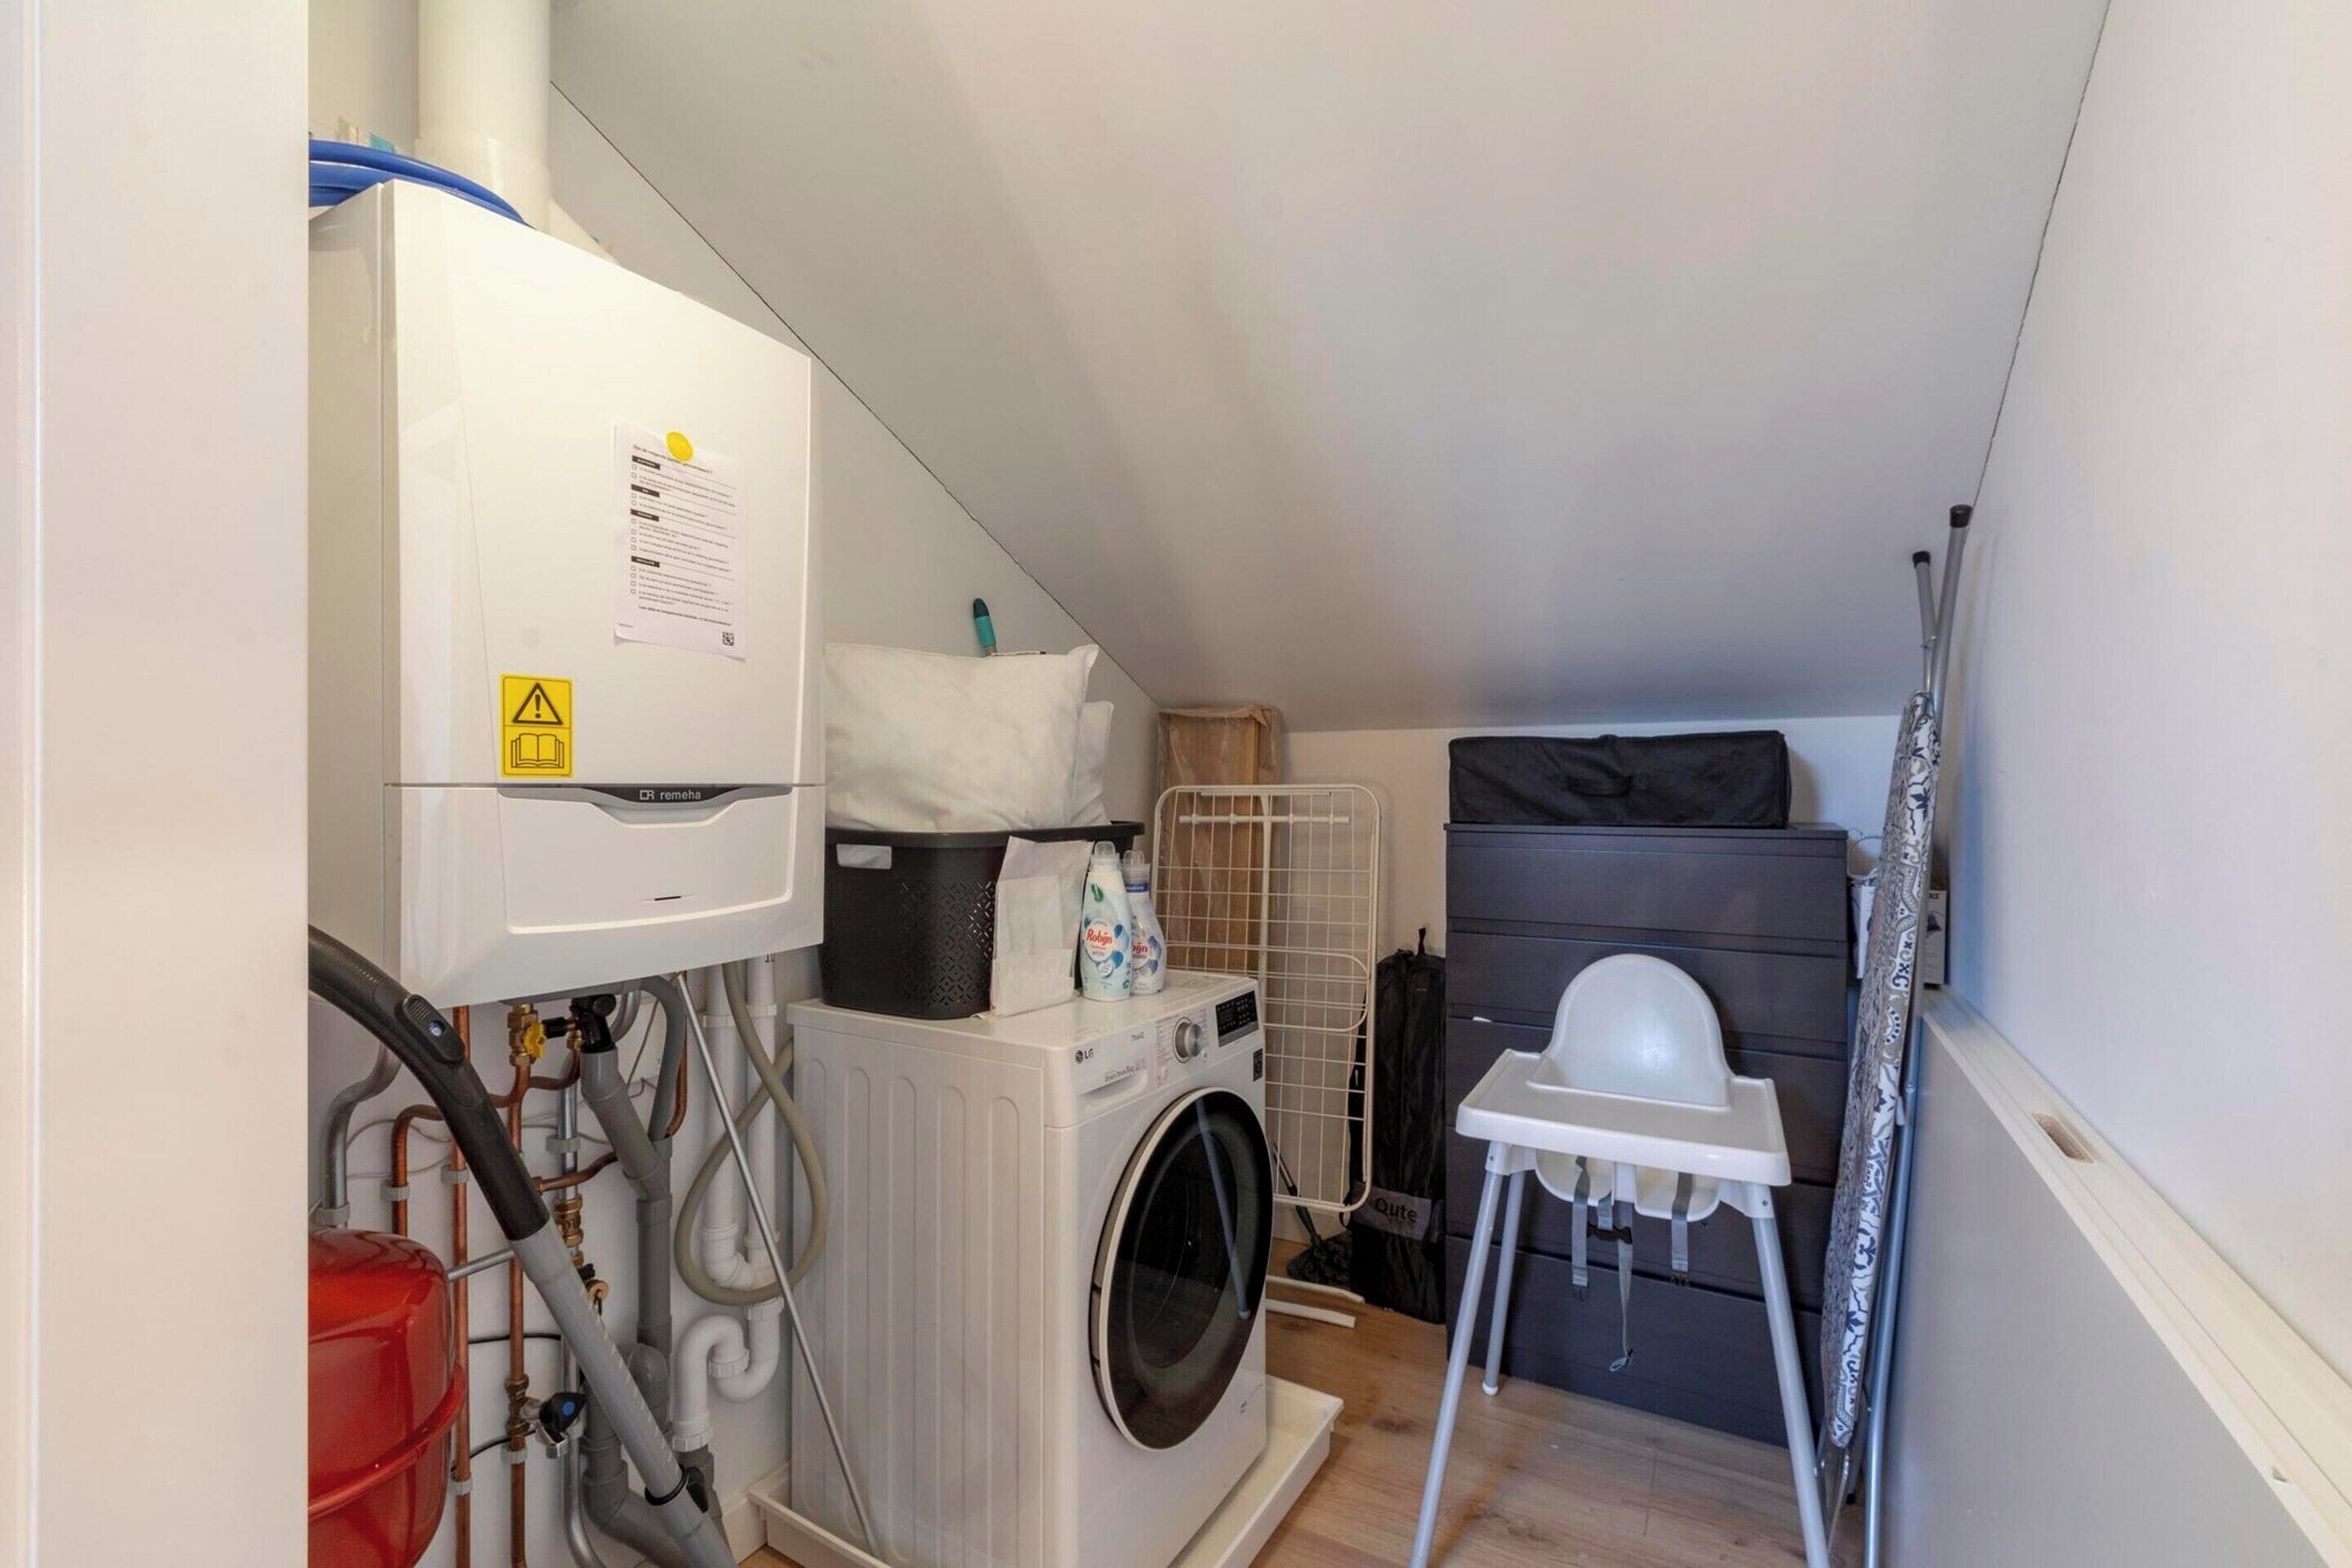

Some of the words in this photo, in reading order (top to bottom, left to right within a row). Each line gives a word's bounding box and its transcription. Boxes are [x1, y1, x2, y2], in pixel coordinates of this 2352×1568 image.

[660, 789, 702, 800] remeha
[1086, 928, 1112, 947] Robijn
[1084, 1048, 1094, 1059] LG
[1375, 1197, 1418, 1225] Qute
